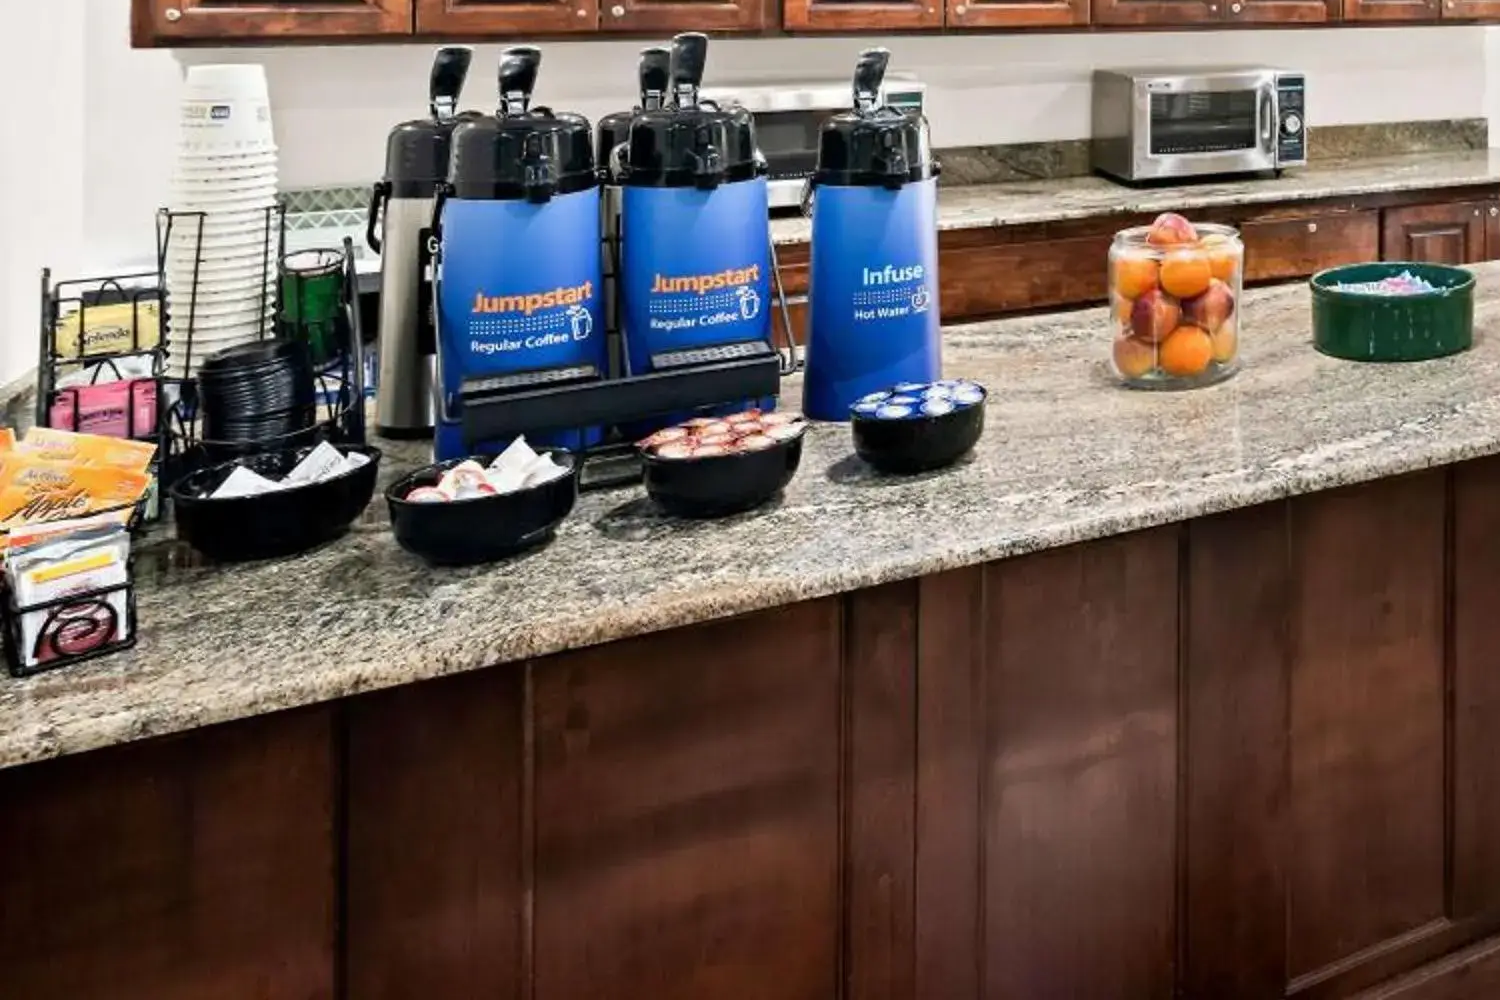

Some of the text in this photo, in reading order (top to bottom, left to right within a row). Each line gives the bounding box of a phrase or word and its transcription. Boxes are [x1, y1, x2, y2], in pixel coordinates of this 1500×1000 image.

[650, 264, 760, 295] Jumpstart
[863, 264, 924, 285] Infuse
[472, 280, 593, 315] Jumpstart
[650, 311, 739, 332] Regular Coffee
[854, 306, 909, 320] Hot Water
[470, 333, 569, 355] Regular Coffee
